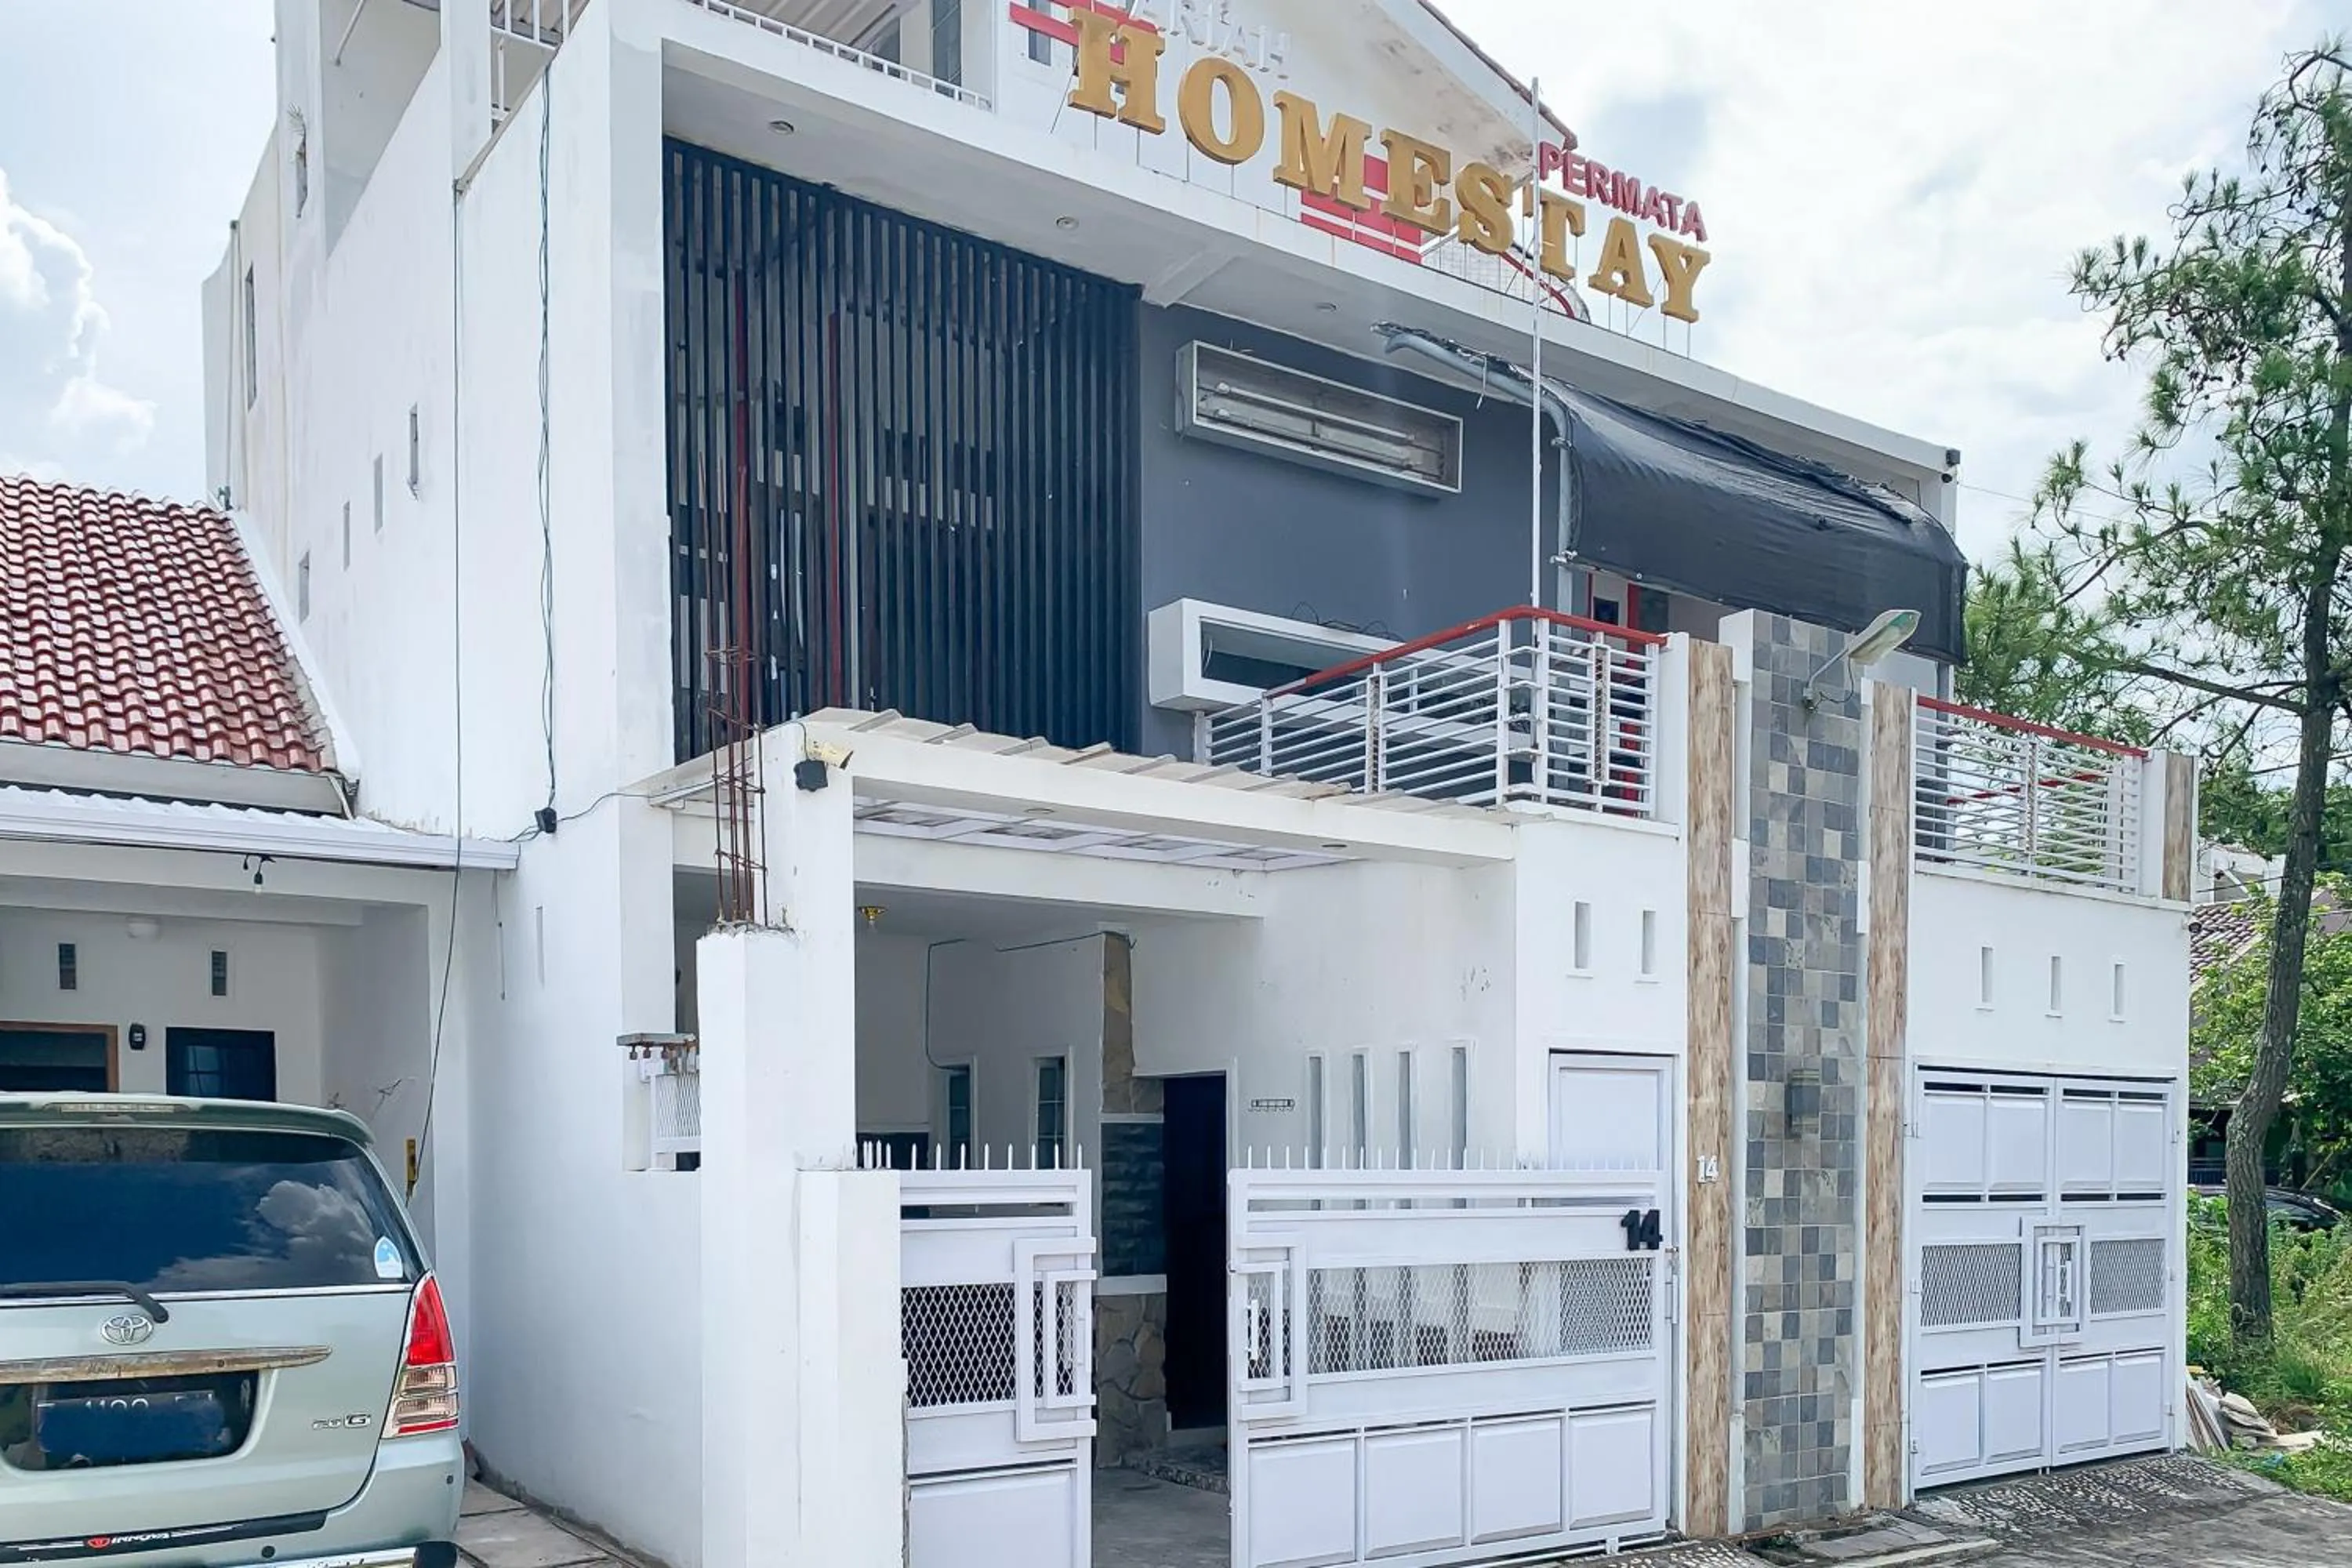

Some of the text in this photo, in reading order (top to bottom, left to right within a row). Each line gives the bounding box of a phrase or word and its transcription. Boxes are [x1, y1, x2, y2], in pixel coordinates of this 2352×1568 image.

[1068, 6, 1711, 323] HOMESTAY
[1539, 141, 1708, 241] PERMATA
[1697, 1155, 1719, 1182] 14
[1621, 1209, 1663, 1250] 14
[344, 1412, 372, 1428] G
